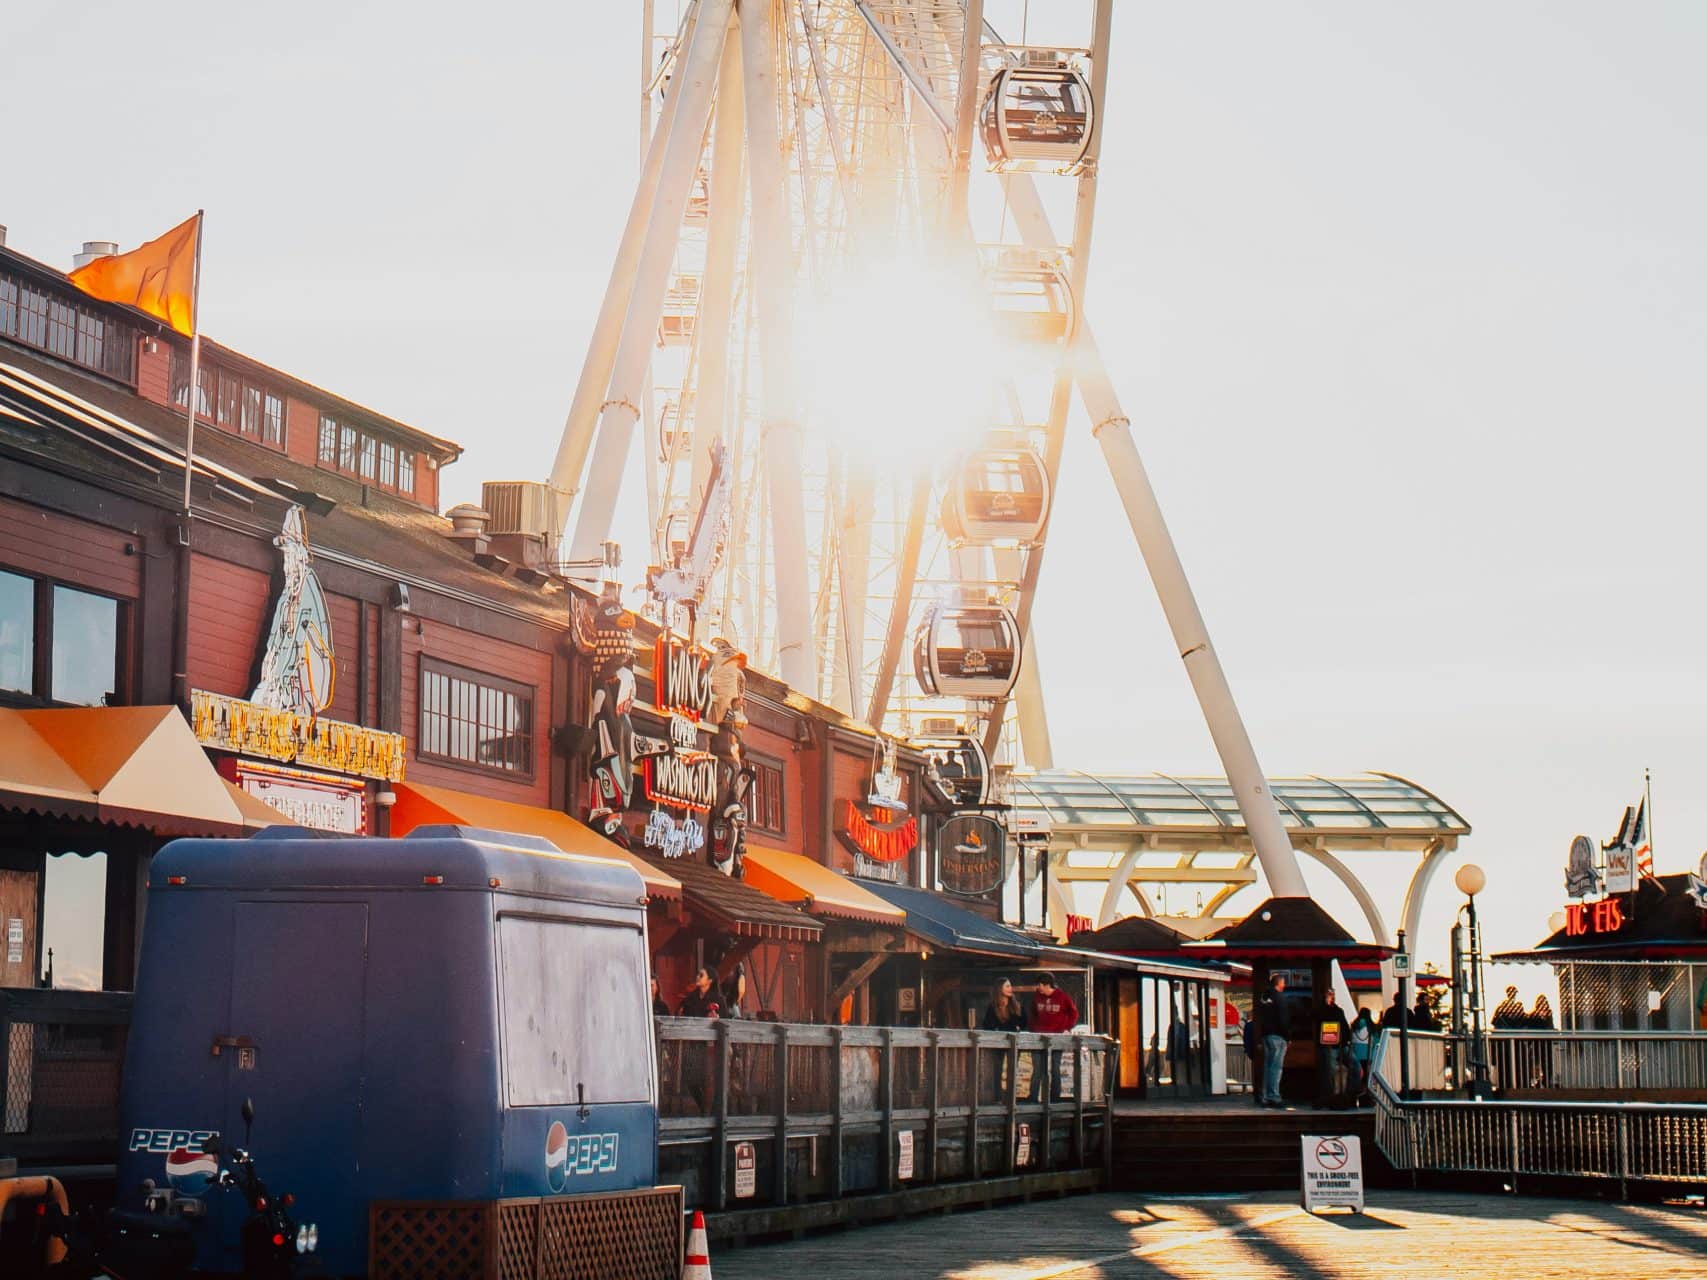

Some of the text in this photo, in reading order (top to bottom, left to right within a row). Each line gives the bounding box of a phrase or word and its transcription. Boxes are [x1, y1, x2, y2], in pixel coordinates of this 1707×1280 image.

[1564, 898, 1622, 936] TICETS
[129, 1128, 220, 1153] PEPS
[564, 1132, 619, 1176] PEPSI
